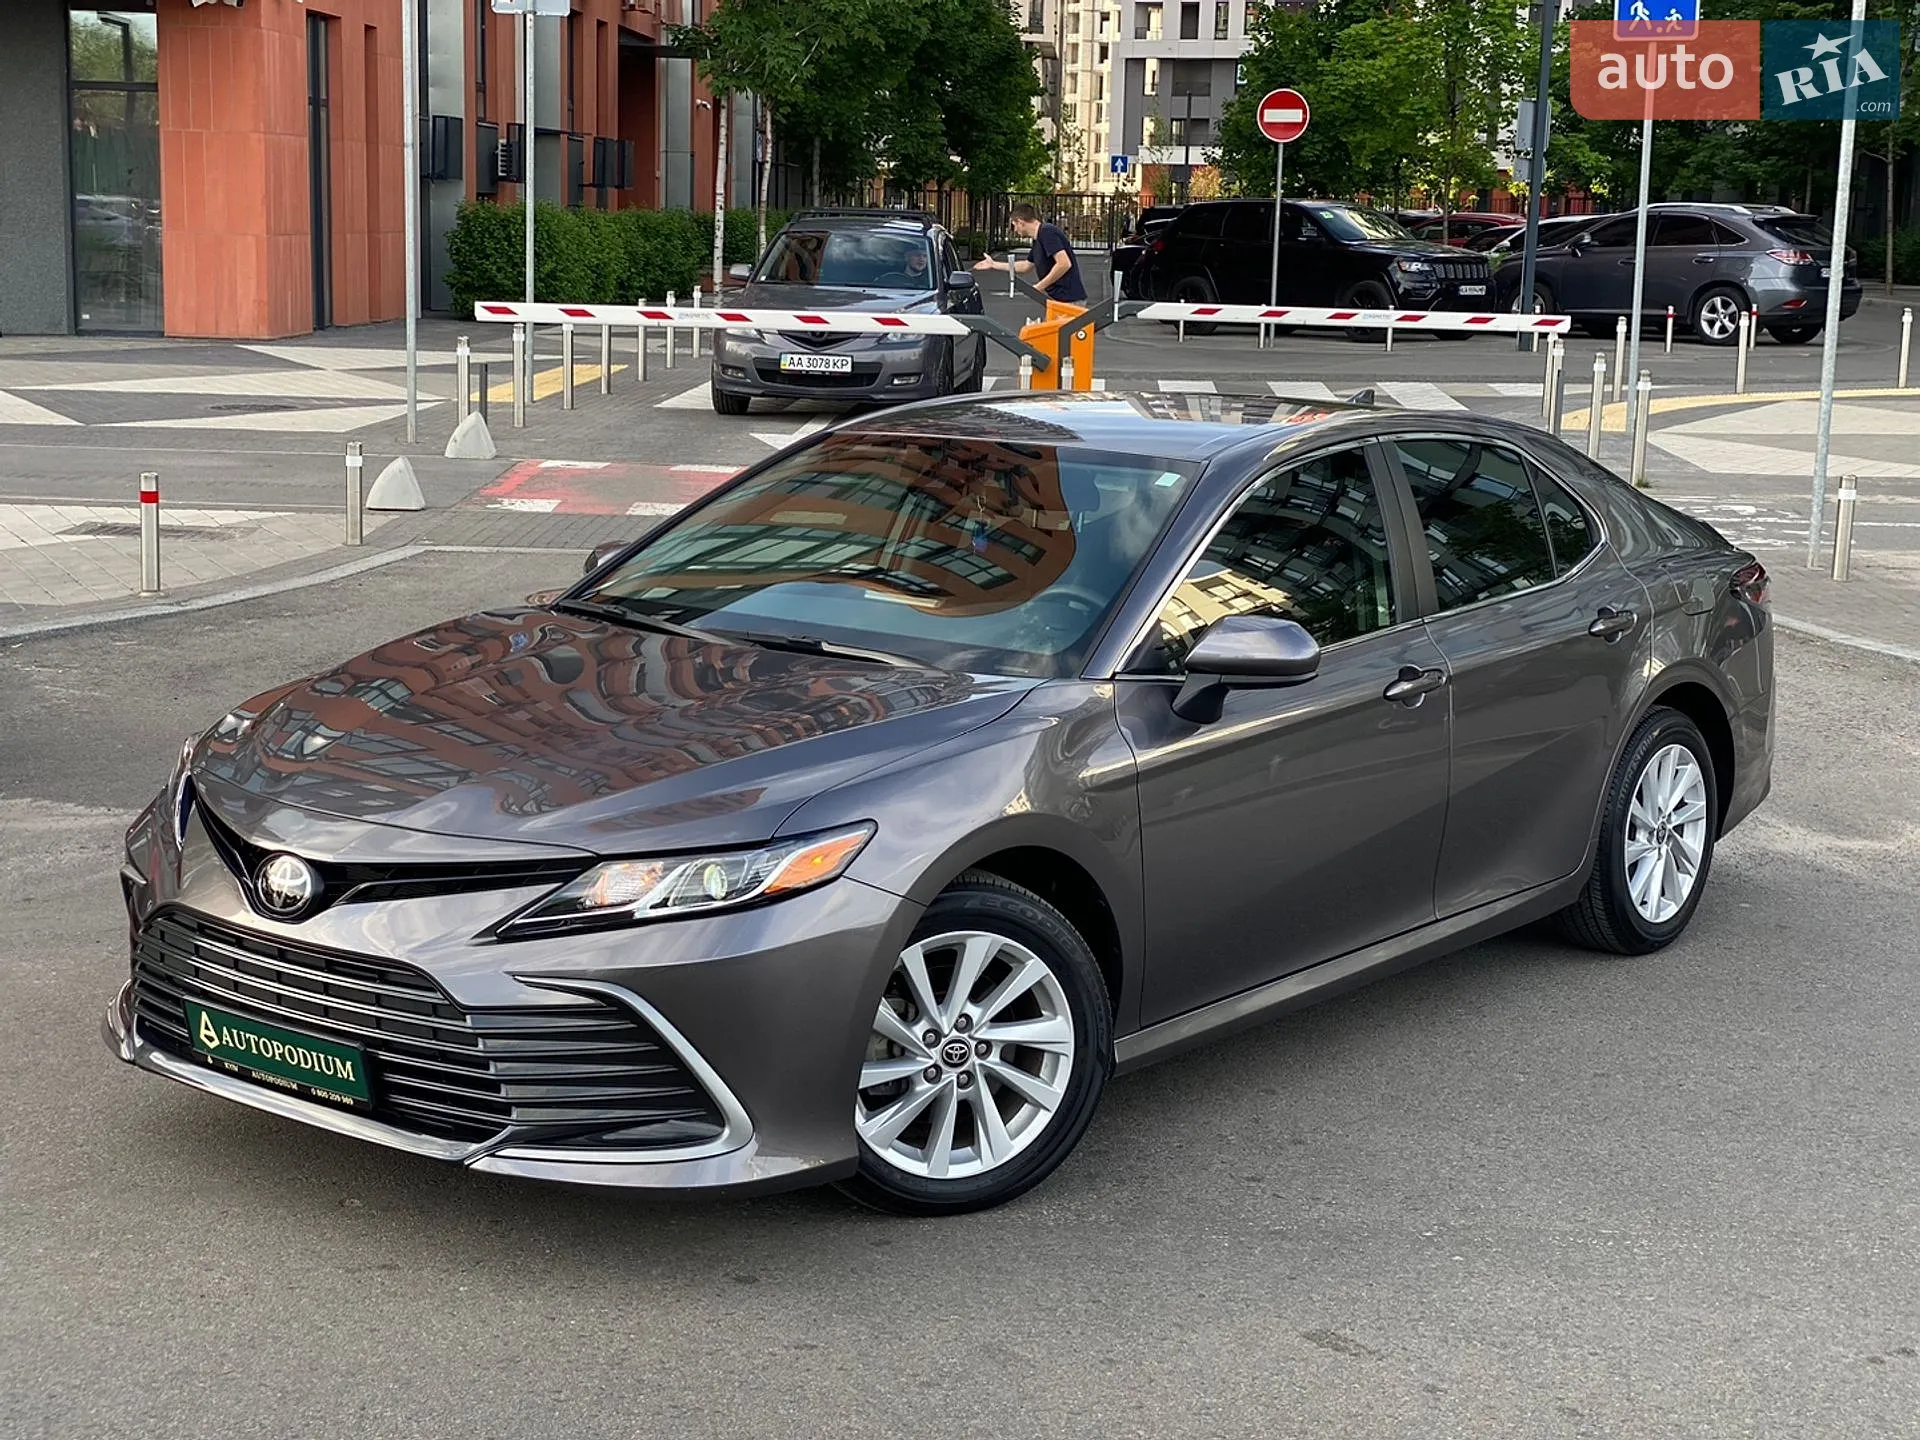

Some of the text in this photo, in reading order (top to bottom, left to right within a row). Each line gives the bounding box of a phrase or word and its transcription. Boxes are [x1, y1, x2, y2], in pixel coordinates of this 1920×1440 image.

[788, 357, 849, 370] AA 3078 KP
[221, 1025, 356, 1082] AUTOPODIUM
